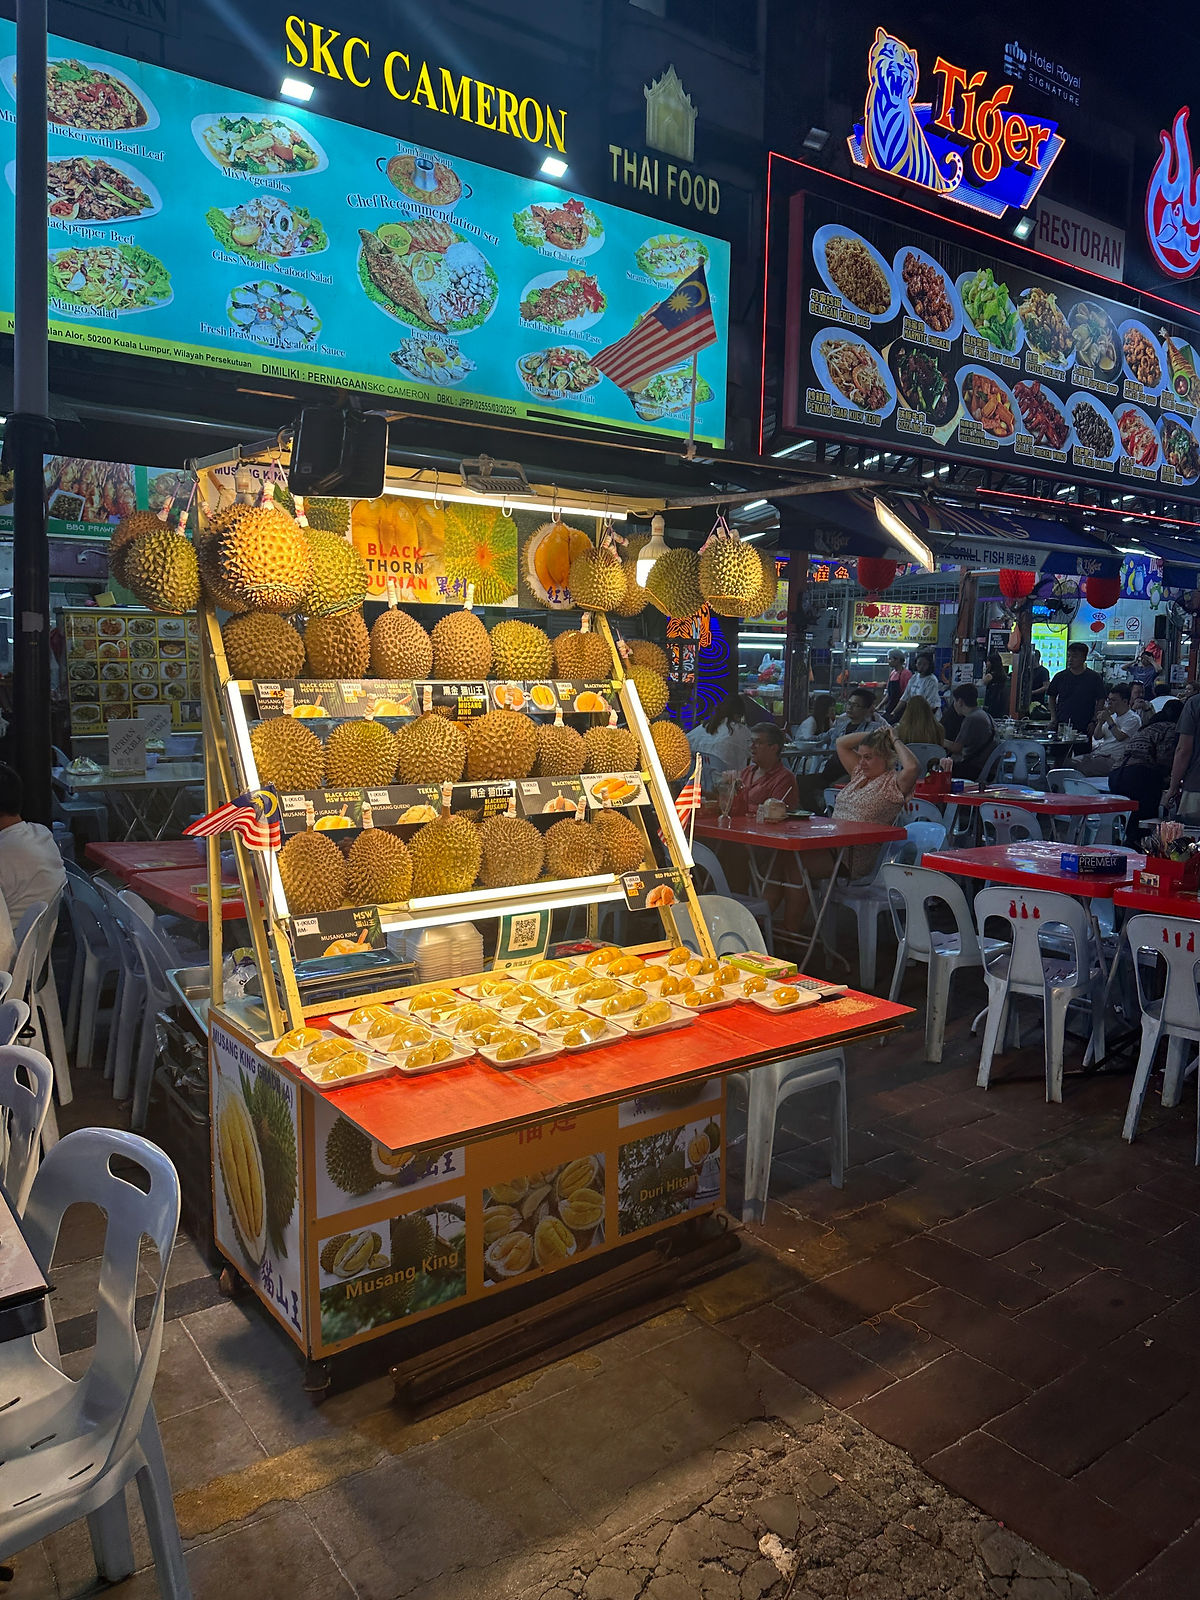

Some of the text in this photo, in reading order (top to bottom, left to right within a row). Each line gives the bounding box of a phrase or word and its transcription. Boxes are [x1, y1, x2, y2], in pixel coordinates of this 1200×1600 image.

[1029, 49, 1081, 88] Hotel Royal
[285, 15, 568, 153] SKC CAMERON
[1028, 73, 1080, 107] SIGNATURE
[933, 56, 1050, 182] Tiger
[47, 123, 164, 162] hicken with Basil Leaf
[222, 166, 291, 193] Mix Vegetables
[609, 144, 720, 215] THAI FOOD
[47, 217, 135, 245] lackpepper Beef
[347, 194, 499, 246] Chef Recommendation set
[1039, 209, 1122, 270] RESTORAN
[212, 250, 333, 285] Glass Noodle Seafood Salad
[52, 298, 118, 320] Mango Salad
[839, 310, 856, 323] FRIED
[856, 314, 870, 327] RICE
[519, 318, 537, 328] Fried
[538, 321, 552, 332] Fish
[200, 322, 226, 337] Fresh
[228, 328, 260, 343] Prawns
[262, 333, 281, 346] with
[322, 344, 346, 357] Sauce
[65, 330, 85, 342] Alor,
[87, 333, 111, 345] 50200
[114, 336, 137, 349] Kuala
[139, 341, 172, 356] Lumpur,
[173, 347, 204, 362] Wilayah
[206, 352, 252, 368] Persekutuan
[262, 363, 300, 379] DIMILIKI
[387, 384, 430, 401] CAMERON
[436, 393, 454, 405] DBKL
[807, 403, 831, 416] PENANG
[832, 407, 848, 420] CHAR
[865, 413, 882, 426] TEOW
[921, 424, 935, 436] BEEF
[368, 543, 423, 560] BLACK
[983, 550, 1004, 564] FISH
[366, 559, 424, 574] THORN
[111, 728, 135, 755] DURIAN
[122, 735, 144, 756] TABLE
[417, 787, 438, 795] TEKKA
[485, 802, 507, 810] MUSANG
[353, 910, 373, 920] MSW
[321, 933, 345, 941] MUSANG
[212, 1027, 238, 1060] MUSANG
[240, 1048, 256, 1074] KING
[640, 1172, 699, 1202] Duri Hitam
[346, 1251, 459, 1300] Musang King
